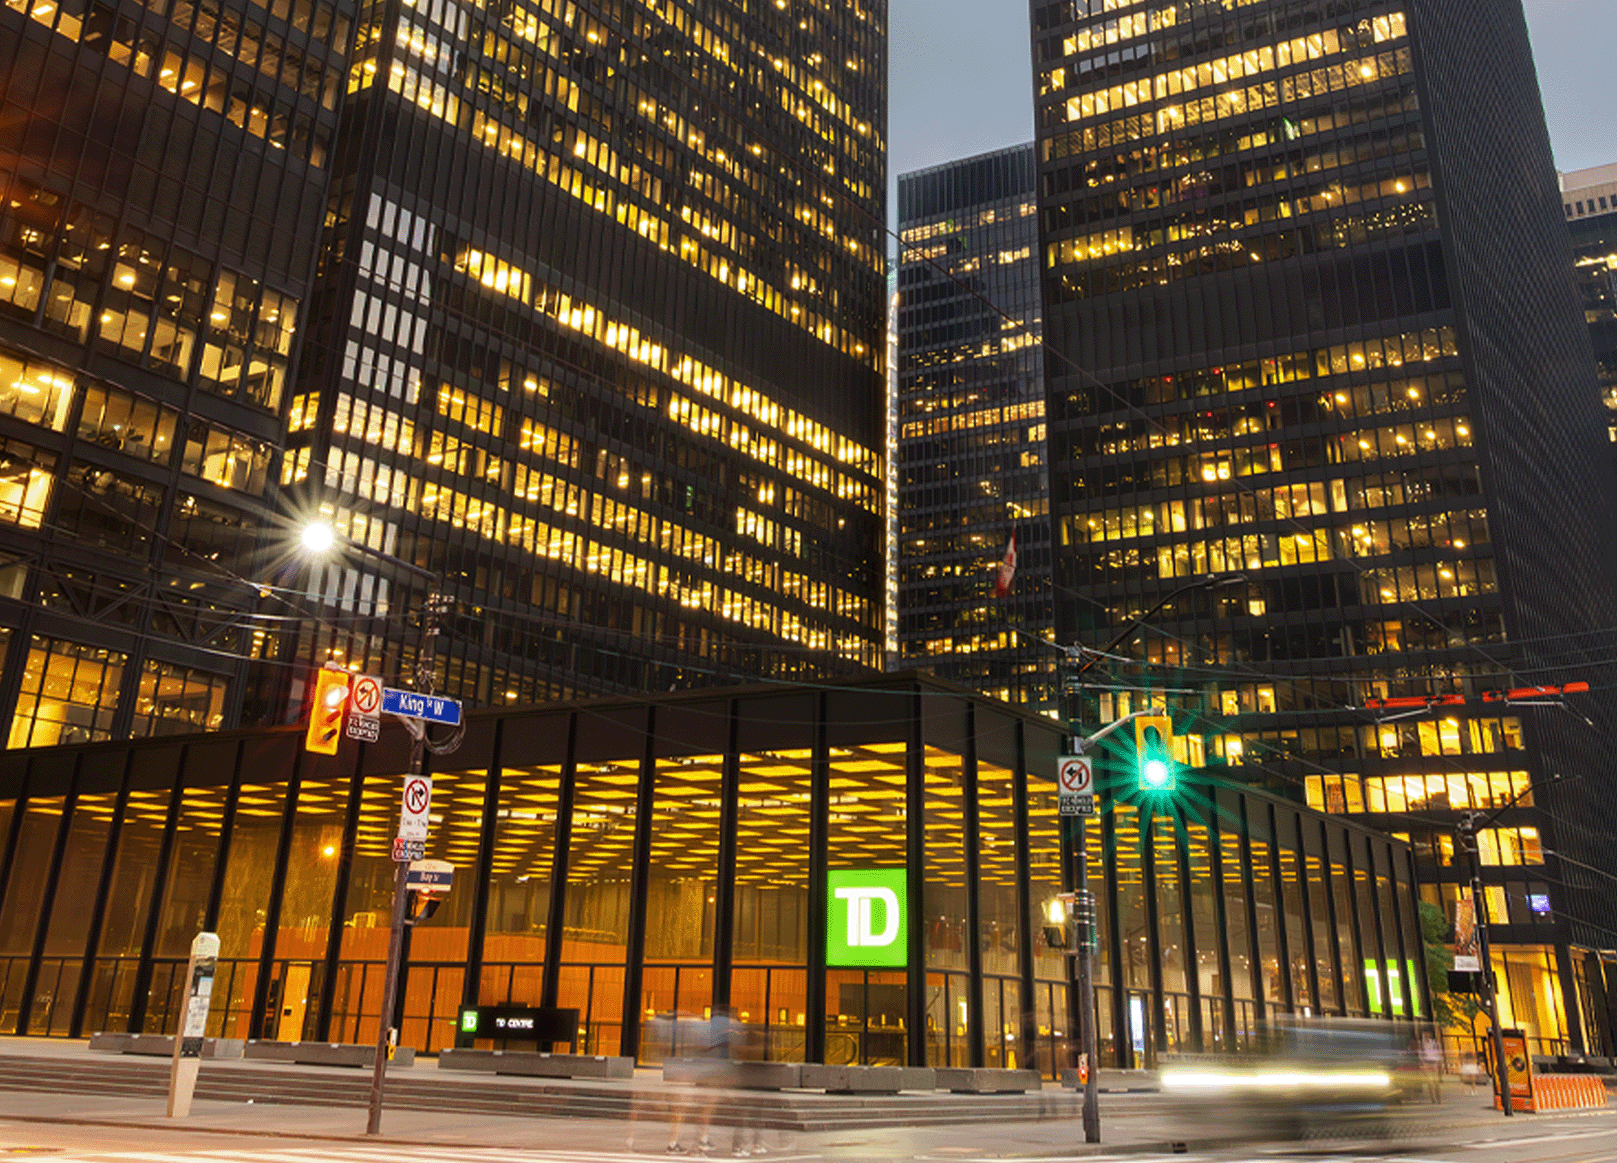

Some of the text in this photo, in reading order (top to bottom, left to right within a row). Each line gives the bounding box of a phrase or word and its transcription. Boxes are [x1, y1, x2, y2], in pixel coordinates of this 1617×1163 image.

[399, 693, 424, 717] King
[434, 700, 445, 716] W
[834, 887, 900, 947] TD
[464, 1016, 477, 1028] TD
